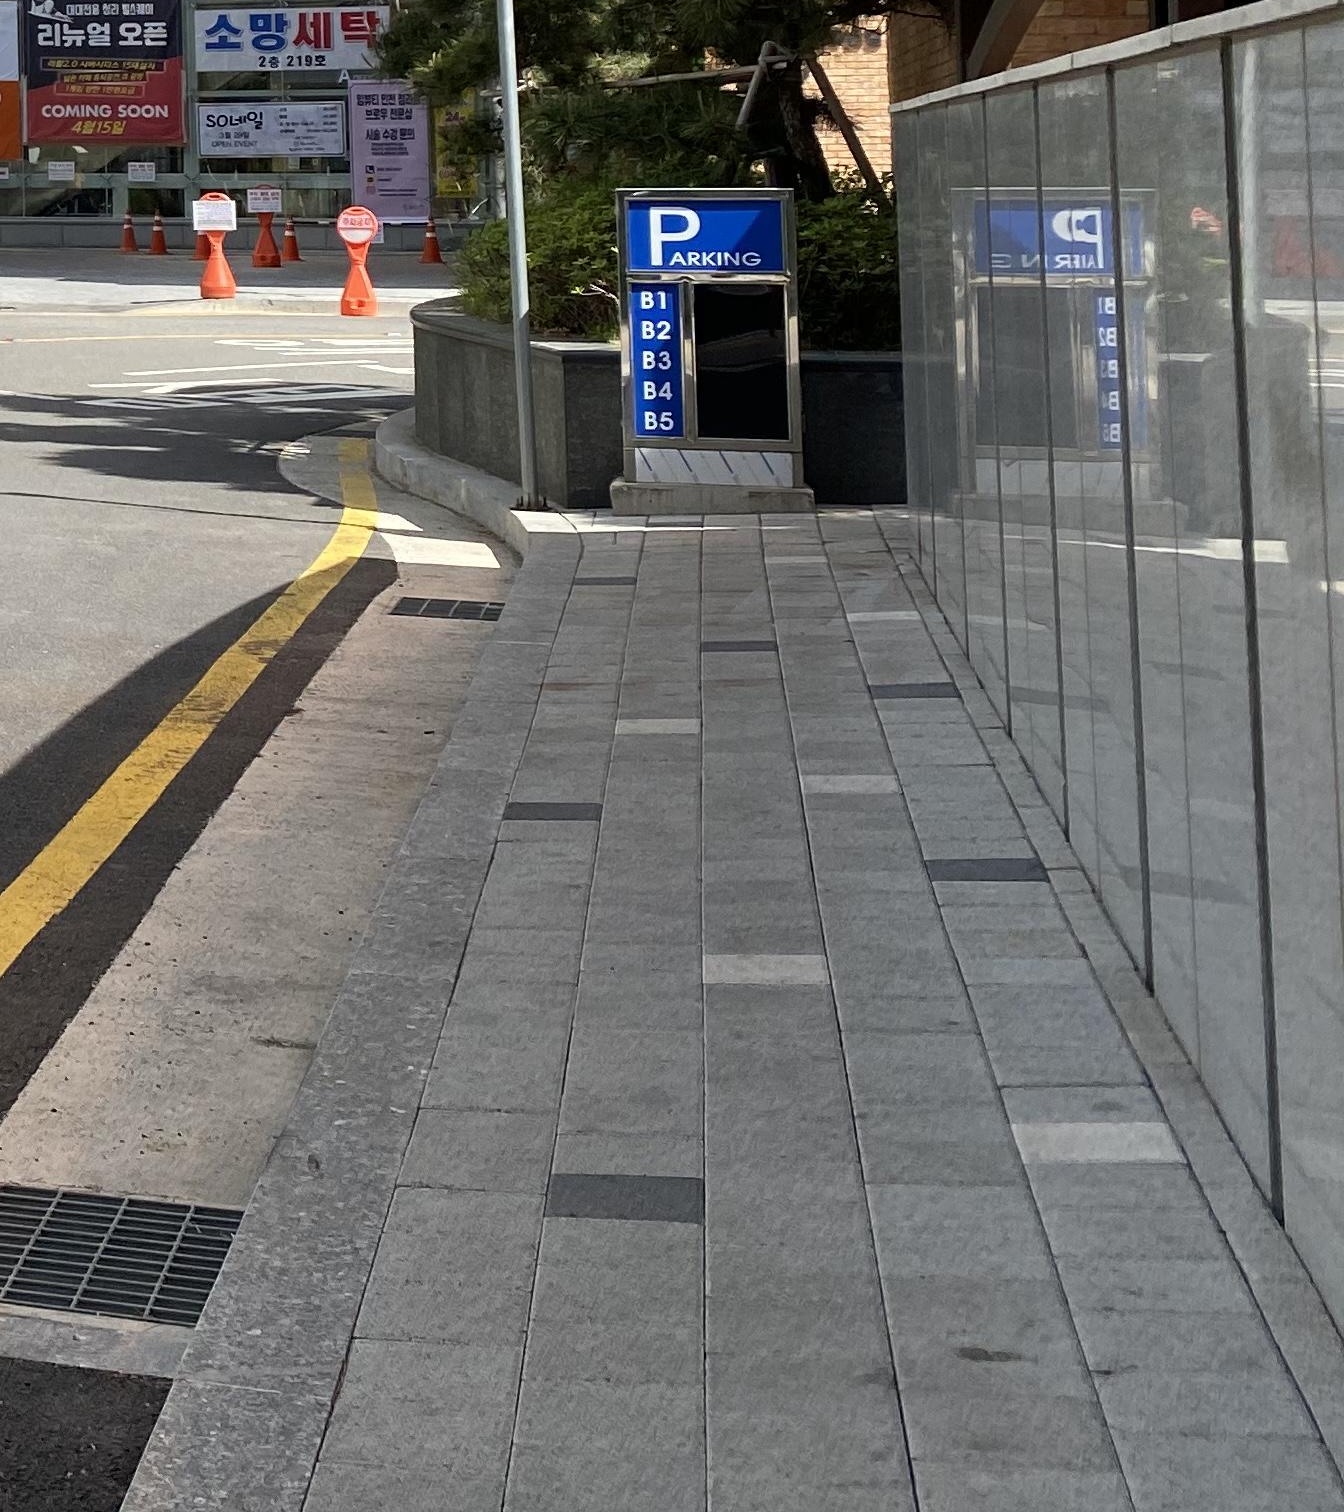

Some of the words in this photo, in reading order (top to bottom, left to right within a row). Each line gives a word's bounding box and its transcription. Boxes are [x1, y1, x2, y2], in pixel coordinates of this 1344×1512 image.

[37, 22, 112, 47] 리뉴얼
[118, 22, 168, 47] 오픈
[205, 11, 381, 53] 소망세탁
[258, 56, 280, 69] 2층
[287, 55, 327, 67] 219호
[41, 105, 112, 118] COMING
[118, 104, 169, 118] SOON
[206, 111, 263, 129] SO네일
[71, 120, 126, 135] 4월15일
[649, 206, 762, 267] PARKING
[640, 291, 667, 310] B1
[641, 321, 672, 340] B2
[642, 350, 672, 370] B3
[643, 381, 673, 401] B4
[644, 411, 674, 431] B5
